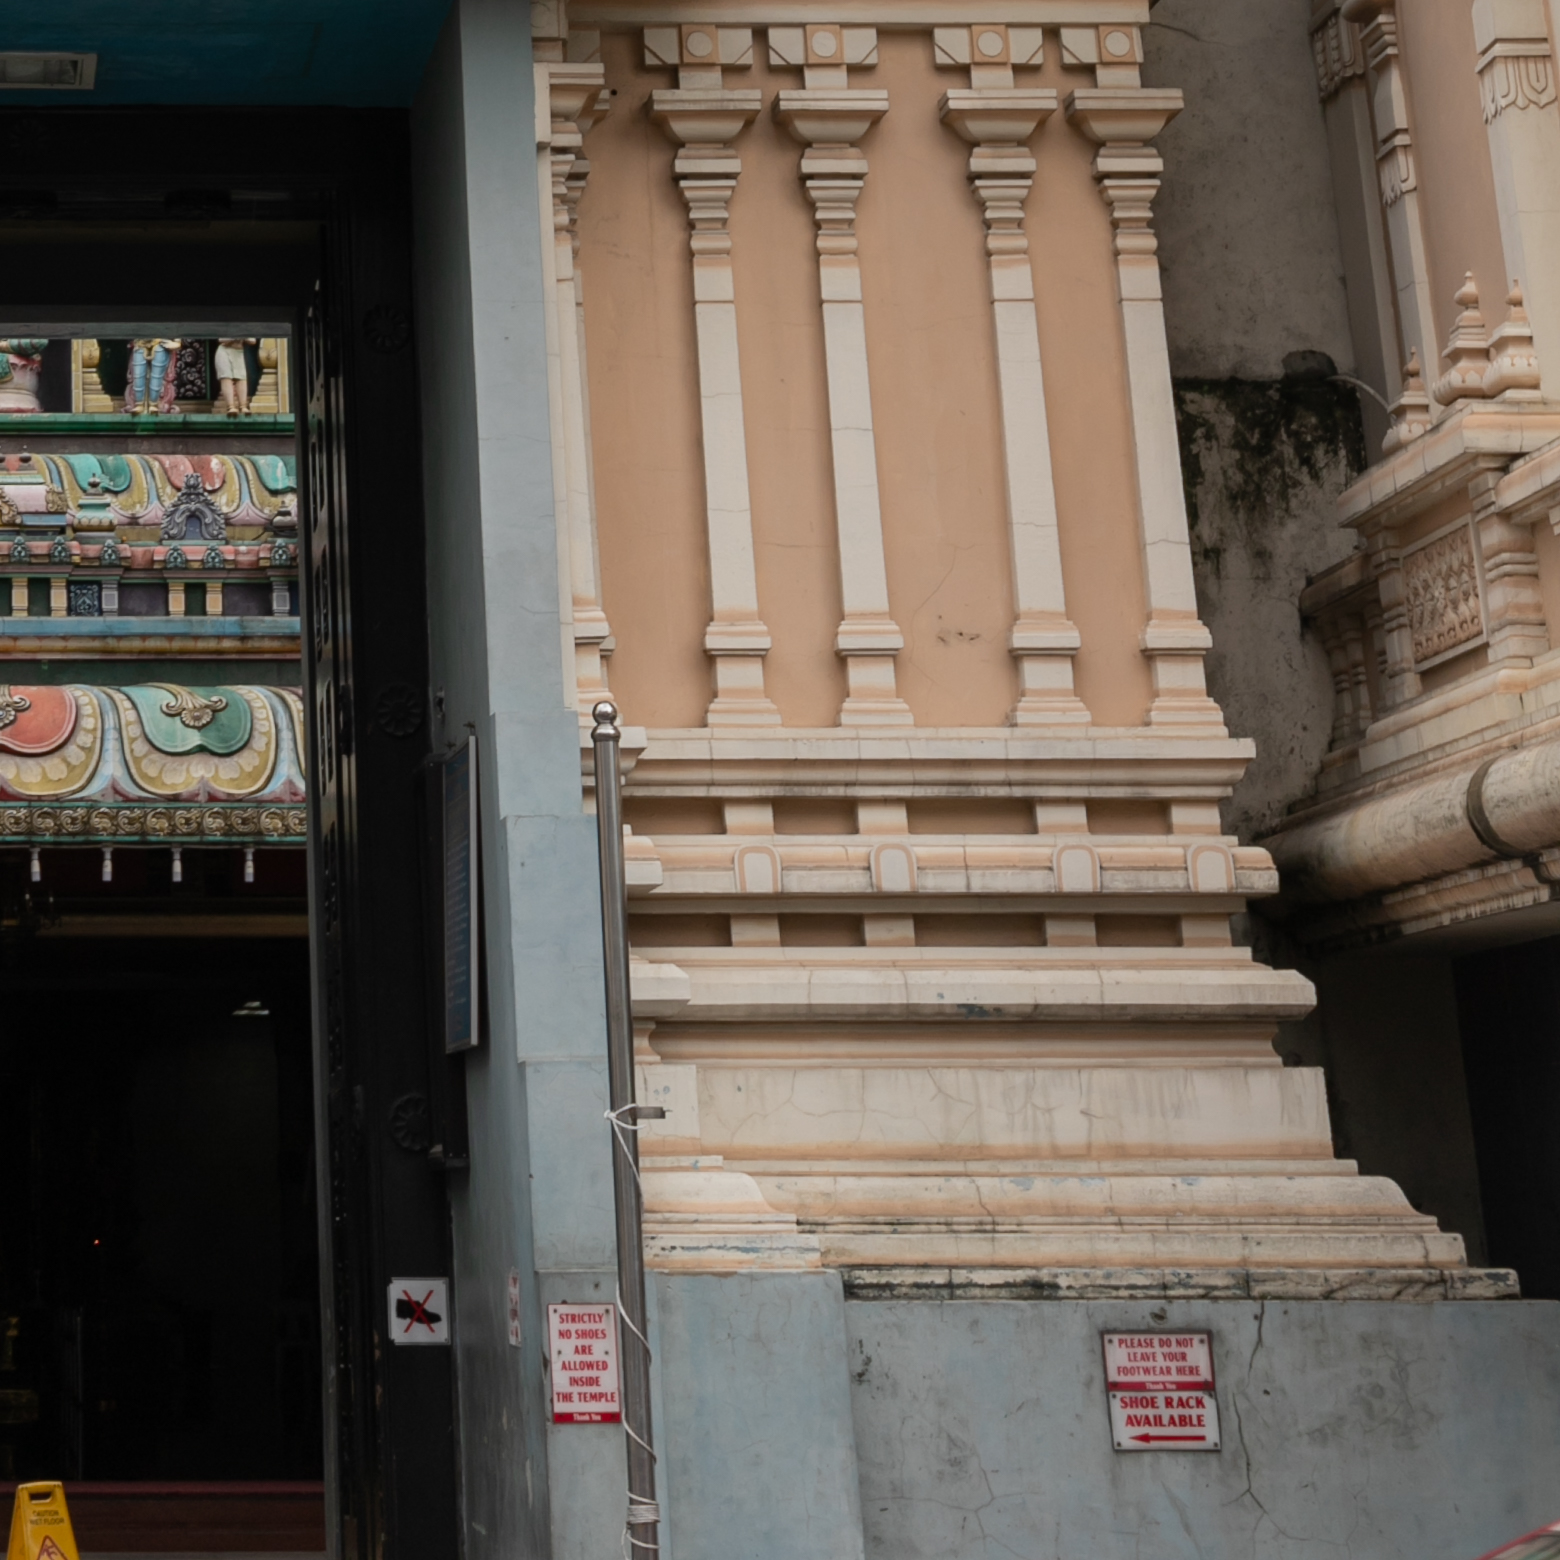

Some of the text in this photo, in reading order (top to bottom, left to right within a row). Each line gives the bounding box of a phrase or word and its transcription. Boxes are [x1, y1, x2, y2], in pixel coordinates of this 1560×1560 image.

[559, 1313, 604, 1324] STRICTLY
[558, 1329, 606, 1339] NO SHOES
[1118, 1338, 1194, 1348] PLEASE DO NOT
[574, 1345, 593, 1355] ARE
[1128, 1352, 1187, 1362] LEAVE YOUR
[561, 1361, 608, 1371] ALLOWED
[1117, 1366, 1201, 1376] FOOTWEAR HERE
[569, 1377, 601, 1386] INSIDE
[556, 1392, 616, 1402] THE TEMPLE
[1120, 1396, 1206, 1409] SHOE RACK
[1126, 1414, 1205, 1427] AVAILABLE
[44, 1517, 64, 1525] FLOOR
